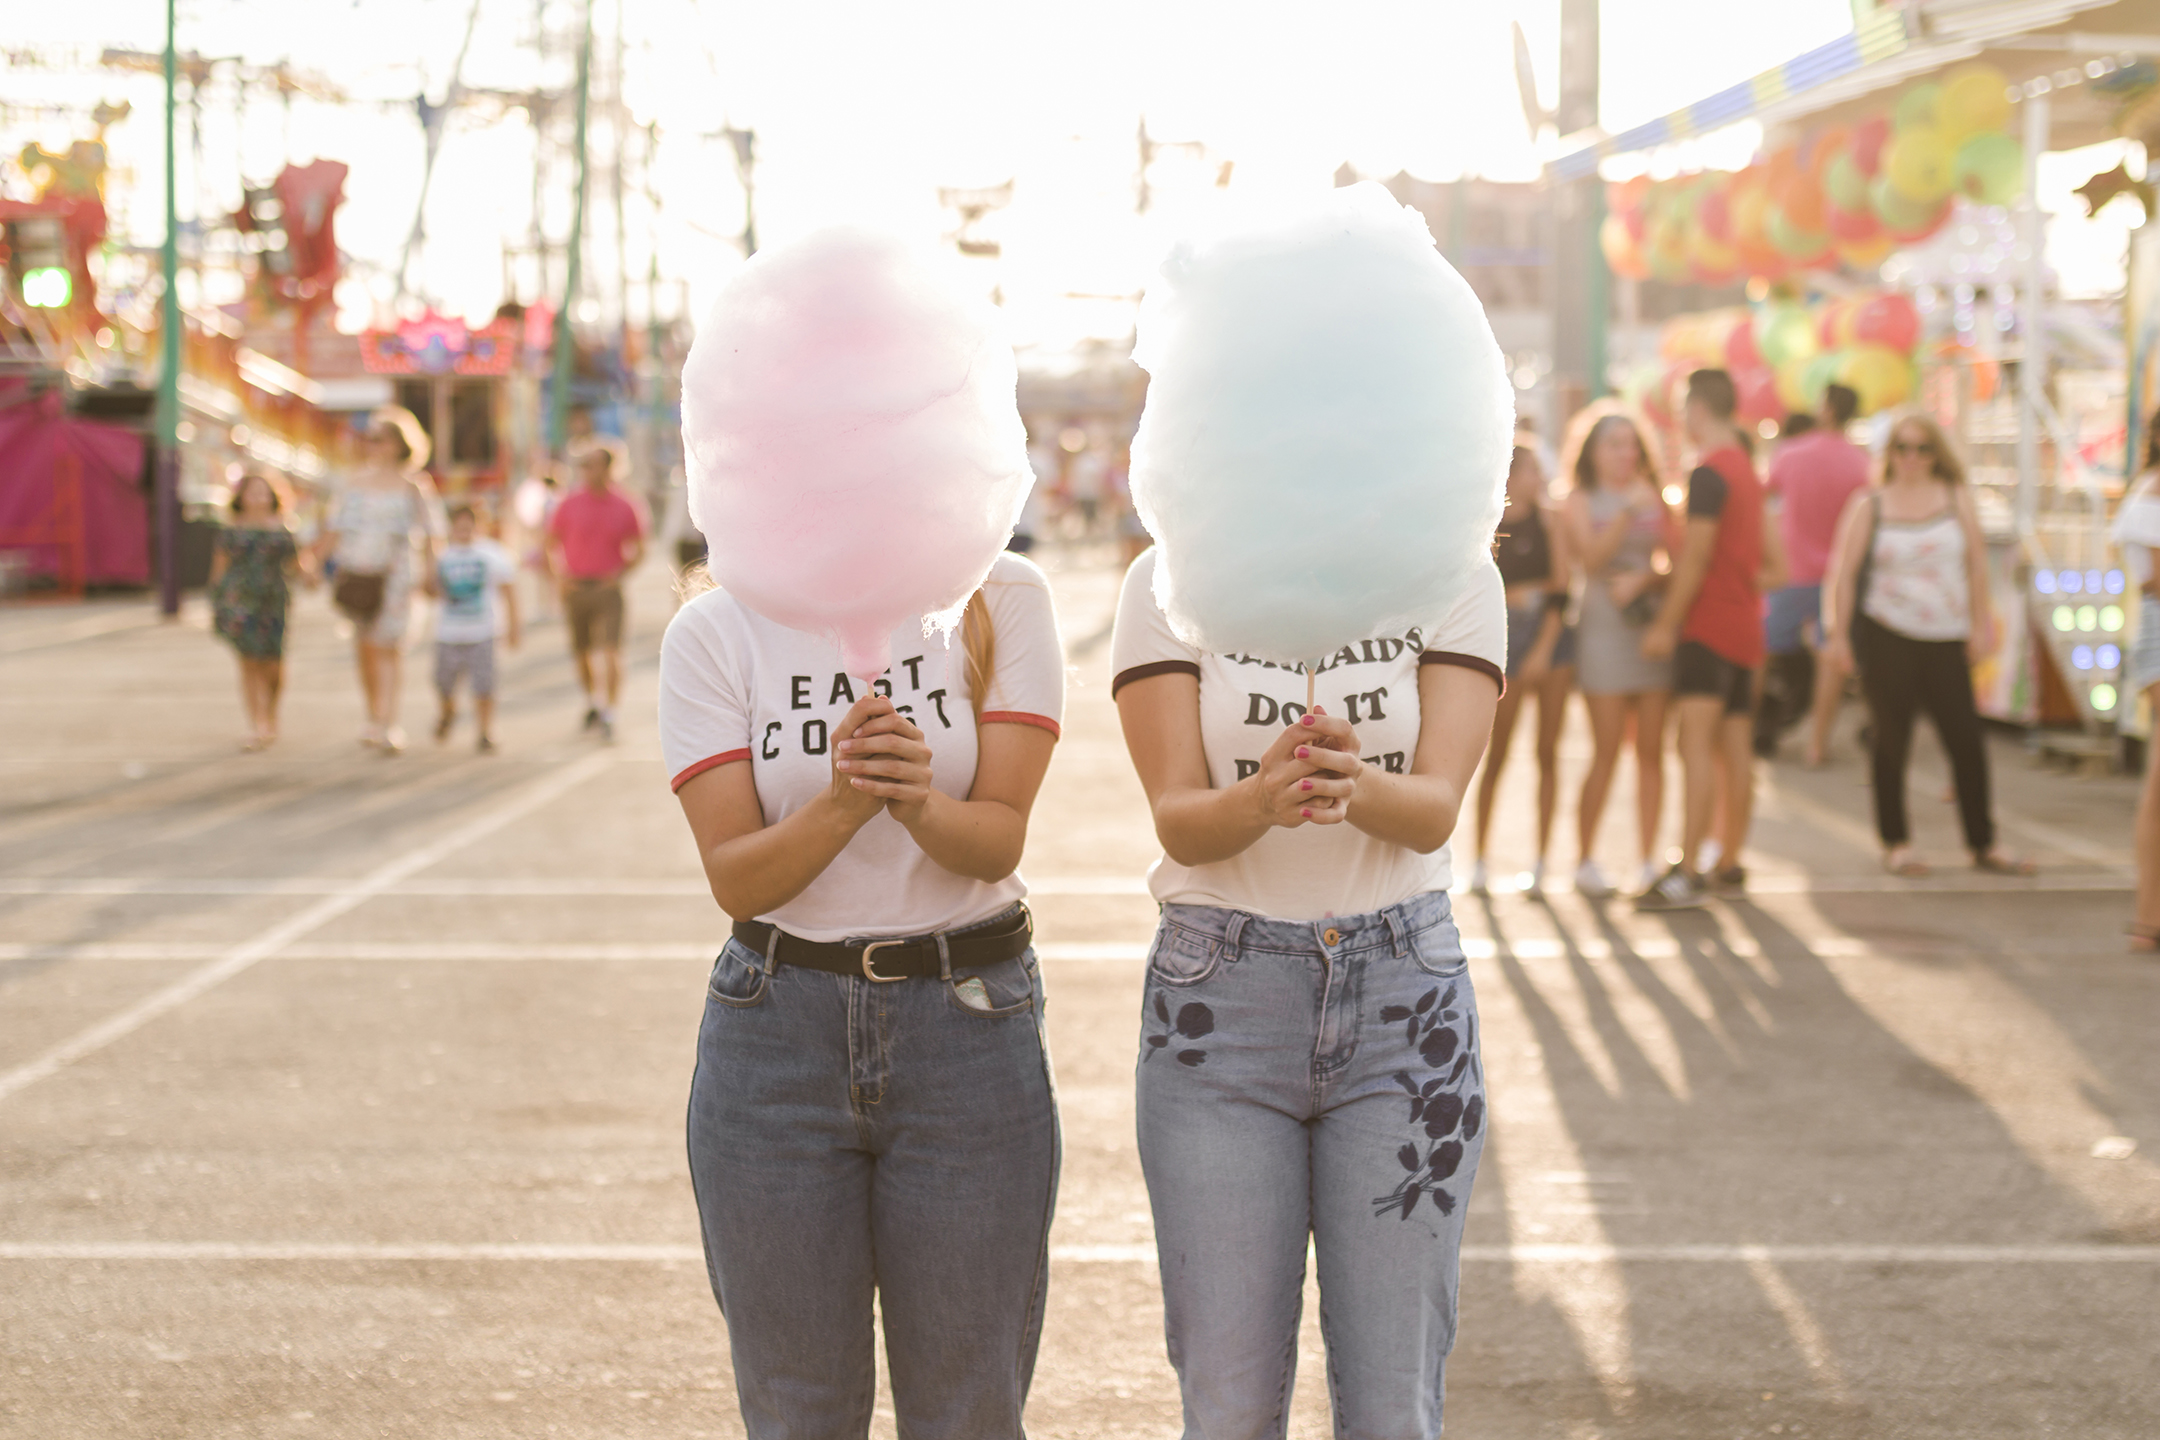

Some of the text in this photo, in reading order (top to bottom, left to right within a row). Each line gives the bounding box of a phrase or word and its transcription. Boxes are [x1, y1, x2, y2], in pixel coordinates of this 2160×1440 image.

[762, 688, 952, 760] COT
[1244, 687, 1388, 727] DO IT
